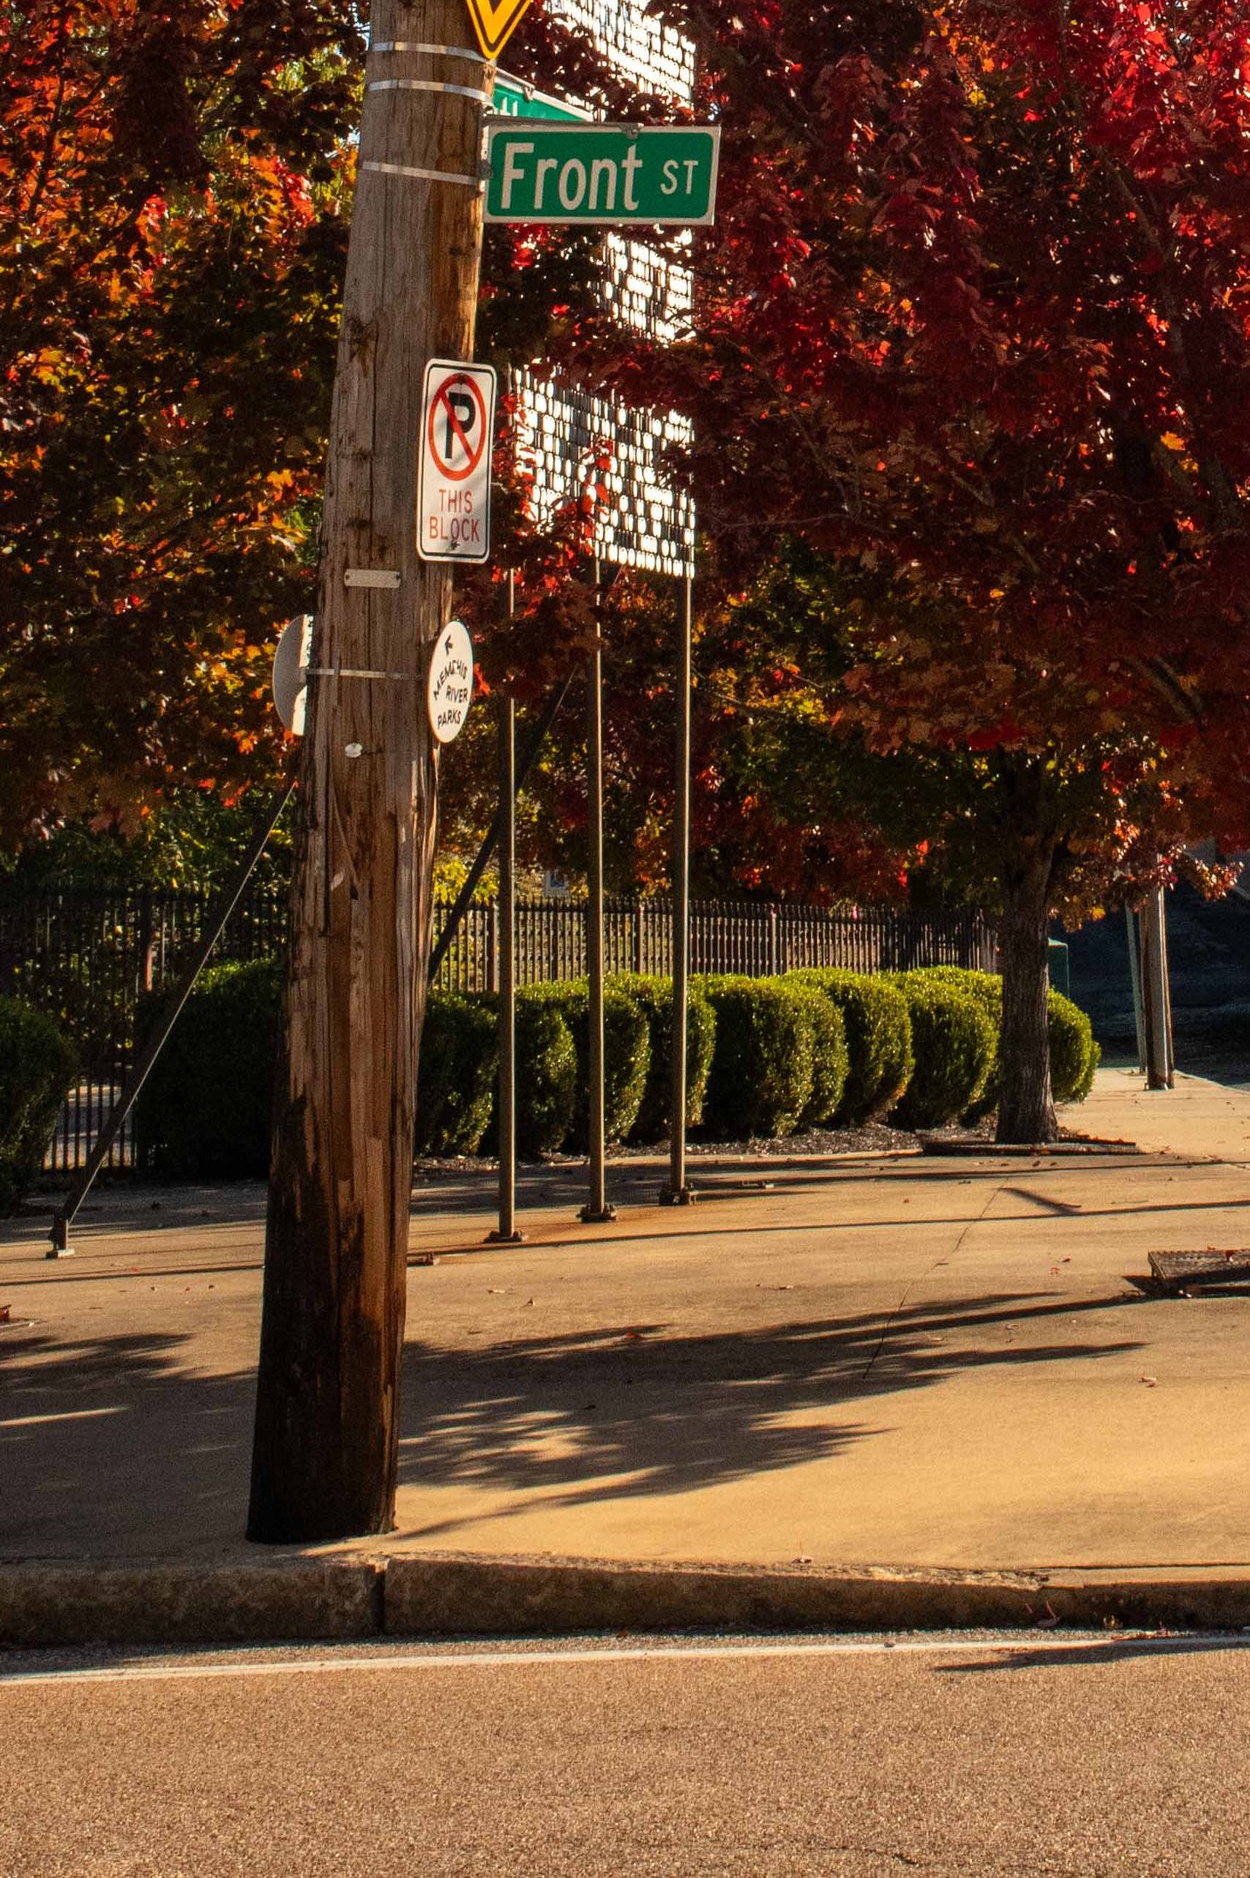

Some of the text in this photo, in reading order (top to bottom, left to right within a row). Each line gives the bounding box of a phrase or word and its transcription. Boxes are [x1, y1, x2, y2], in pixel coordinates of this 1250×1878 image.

[501, 142, 698, 211] Front ST
[439, 489, 472, 514] THIS
[429, 516, 480, 543] BLOCK
[445, 685, 468, 703] RIVER
[437, 709, 462, 730] PARKS
